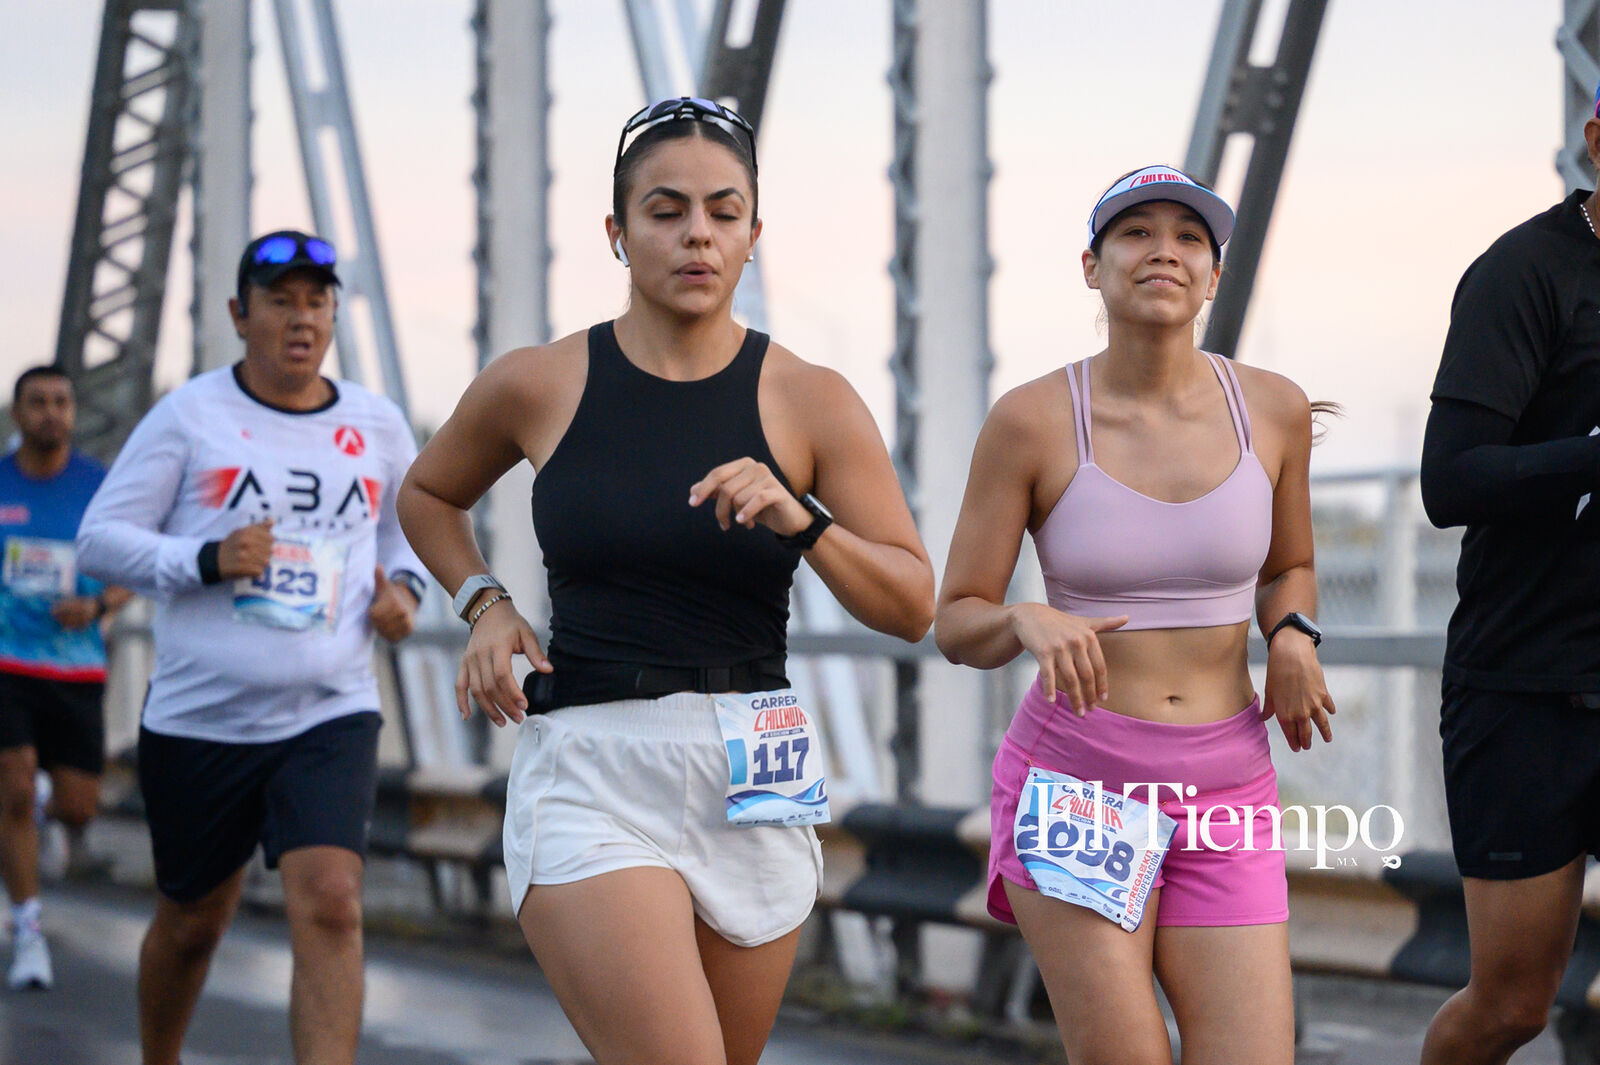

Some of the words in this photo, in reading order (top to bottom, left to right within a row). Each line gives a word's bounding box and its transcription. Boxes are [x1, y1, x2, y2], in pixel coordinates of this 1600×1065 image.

[751, 696, 797, 710] CARRER
[753, 737, 809, 786] 117
[1017, 814, 1134, 882] 2098
[1127, 872, 1144, 915] ENTREGA
[1143, 850, 1153, 865] KIT
[1133, 908, 1141, 920] DE
